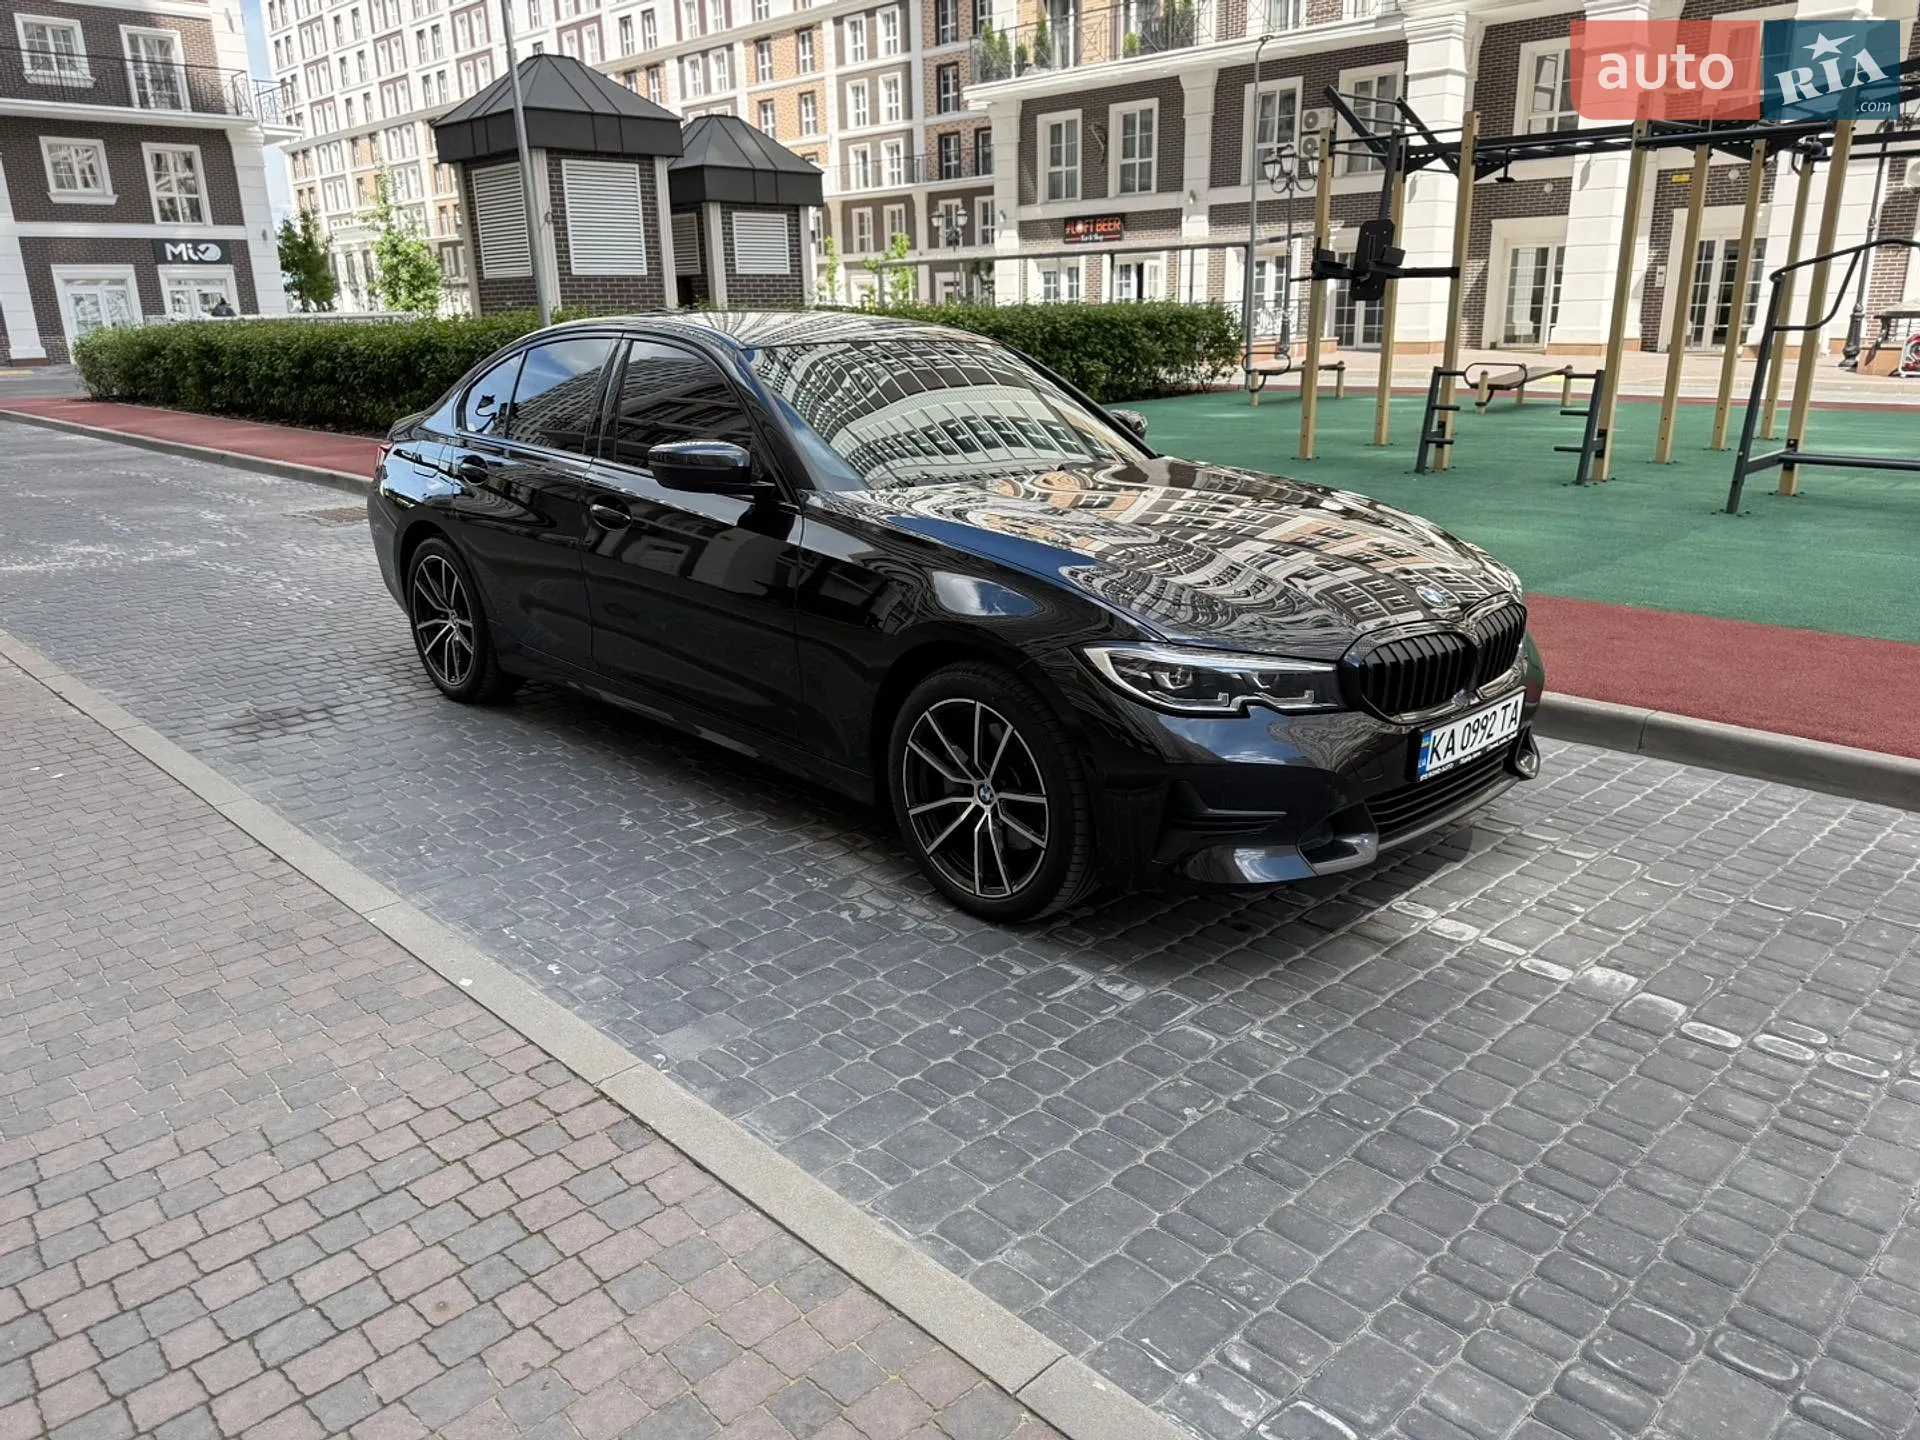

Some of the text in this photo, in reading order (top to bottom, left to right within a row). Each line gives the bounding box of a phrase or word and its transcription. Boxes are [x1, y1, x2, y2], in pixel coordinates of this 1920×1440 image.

[1096, 217, 1121, 232] BEER
[1429, 728, 1455, 765] KA
[1461, 710, 1498, 751] 0992
[1500, 699, 1519, 732] TA
